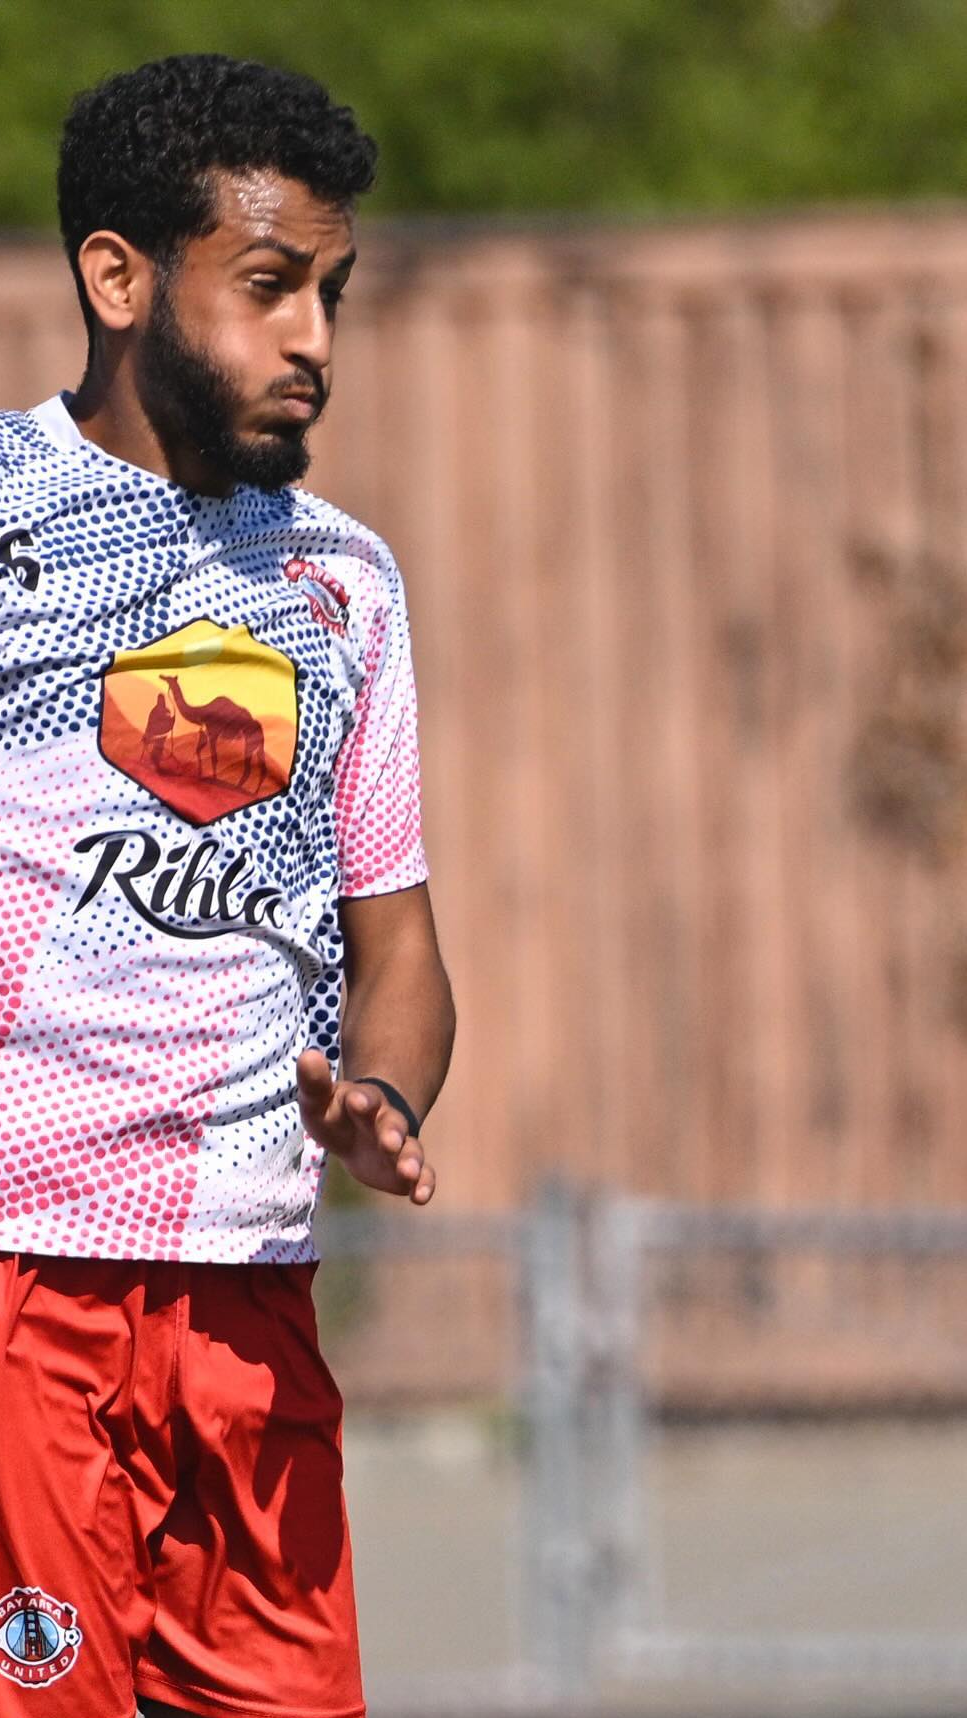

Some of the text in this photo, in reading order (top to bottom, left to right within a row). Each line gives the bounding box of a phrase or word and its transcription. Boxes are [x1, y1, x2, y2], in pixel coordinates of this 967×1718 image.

[72, 829, 284, 940] Rihla
[28, 1598, 62, 1620] AREA
[1, 1655, 69, 1678] UNITED
